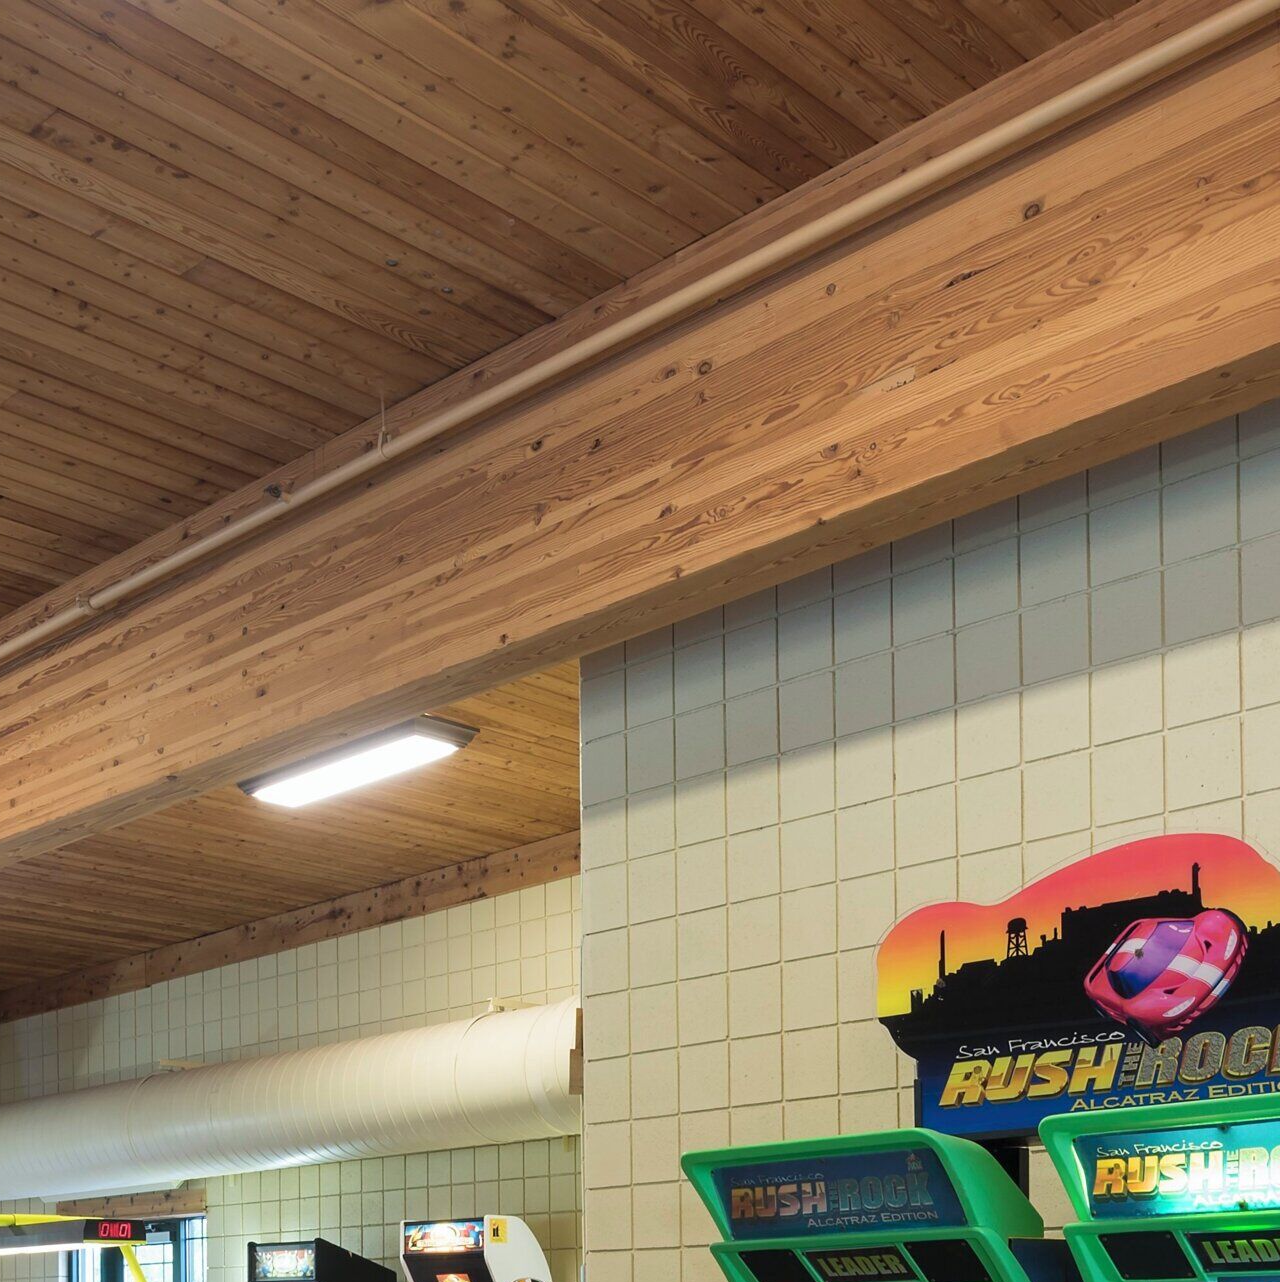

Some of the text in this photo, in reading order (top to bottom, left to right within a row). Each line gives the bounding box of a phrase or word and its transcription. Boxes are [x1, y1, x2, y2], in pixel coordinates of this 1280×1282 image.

[958, 1030, 1126, 1062] San Francisco
[939, 1043, 1124, 1110] RUSH
[1120, 1041, 1143, 1088] THE
[1069, 1089, 1200, 1113] ALCATRAZ
[1096, 1140, 1224, 1159] San Francisco
[1092, 1150, 1226, 1198] RUSH
[731, 1182, 828, 1219] RUSH
[838, 1172, 934, 1212] ROCK
[807, 1211, 939, 1228] ALCATRAZ EDITION
[818, 1254, 908, 1277] LEADER
